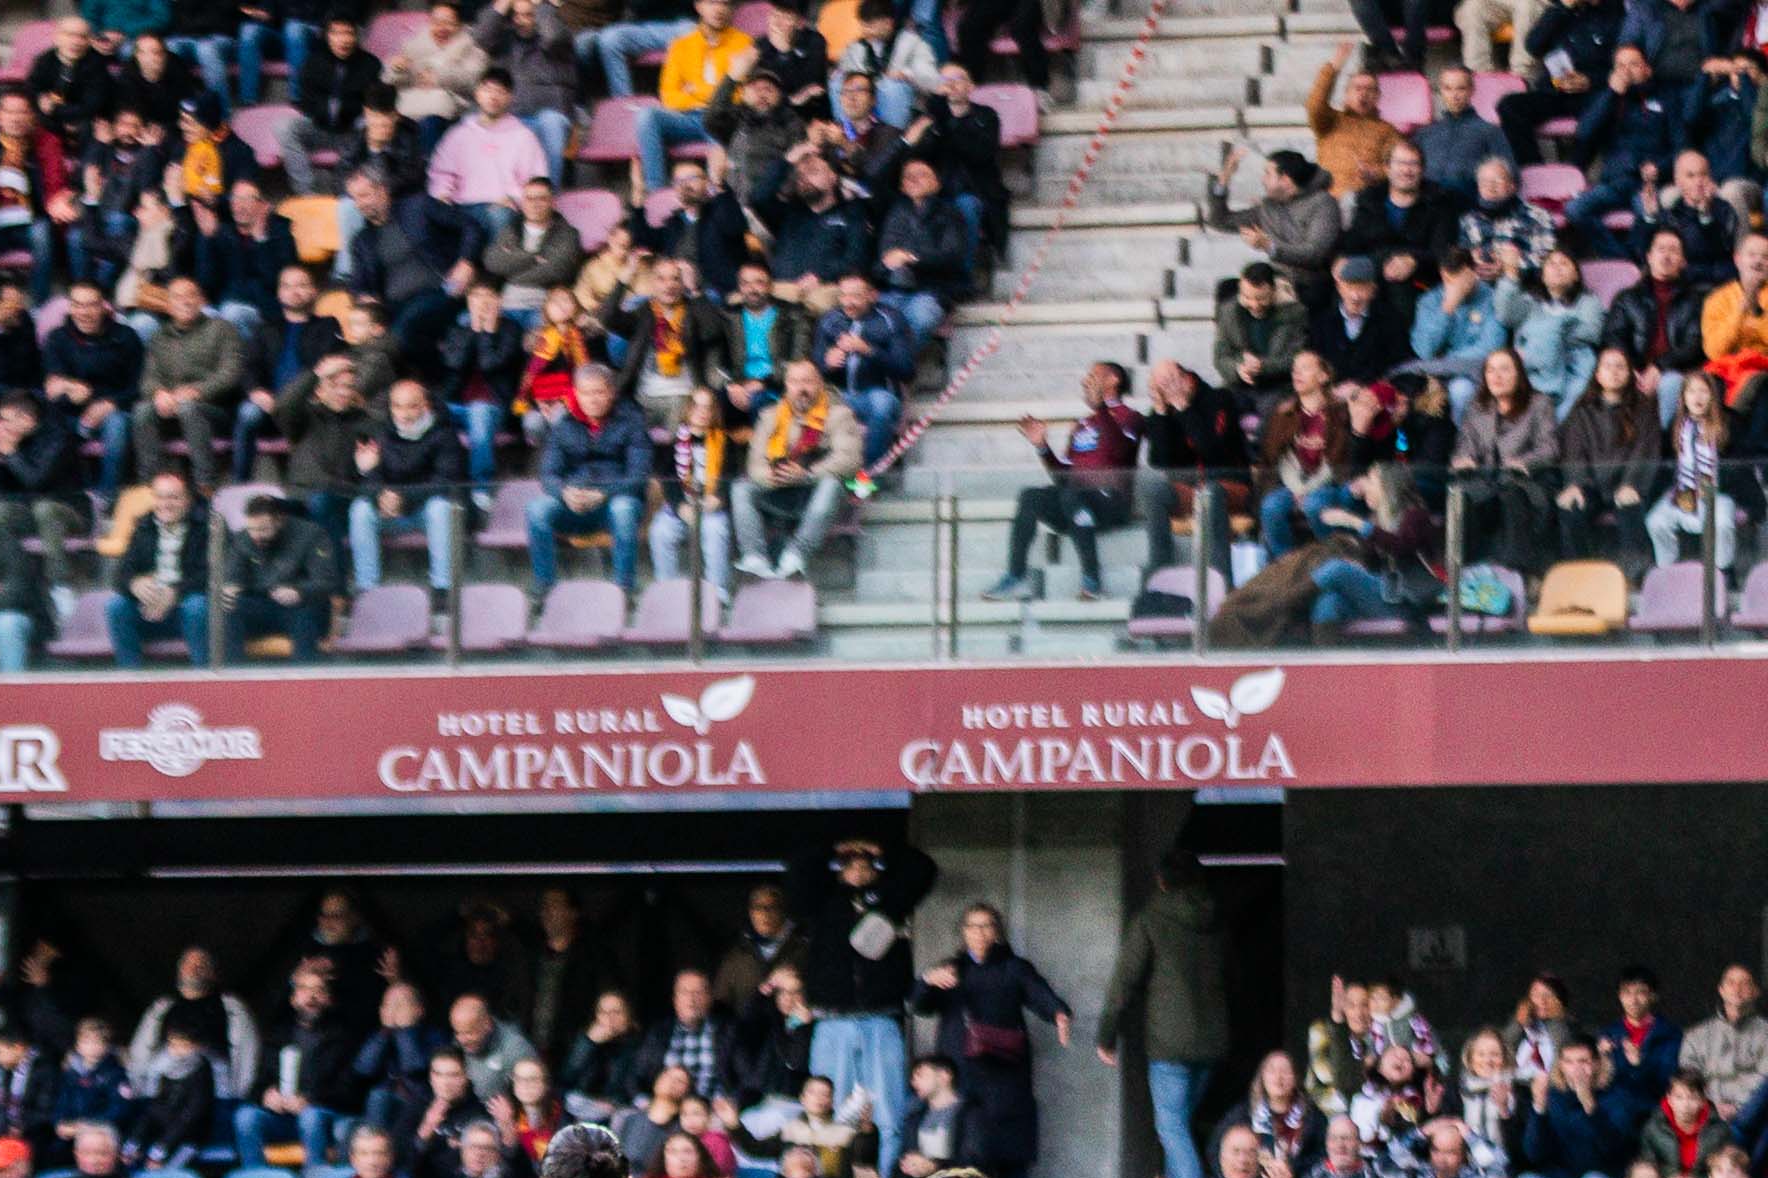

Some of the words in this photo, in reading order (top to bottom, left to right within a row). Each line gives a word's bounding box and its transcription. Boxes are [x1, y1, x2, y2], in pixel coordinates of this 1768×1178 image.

[438, 710, 545, 737] HOTEL
[554, 707, 664, 734] RURAL
[961, 701, 1070, 730] HOTEL
[1080, 699, 1193, 727] RURAL
[377, 741, 768, 793] CAMPANIOLA
[898, 733, 1298, 791] CAMPANIOLA
